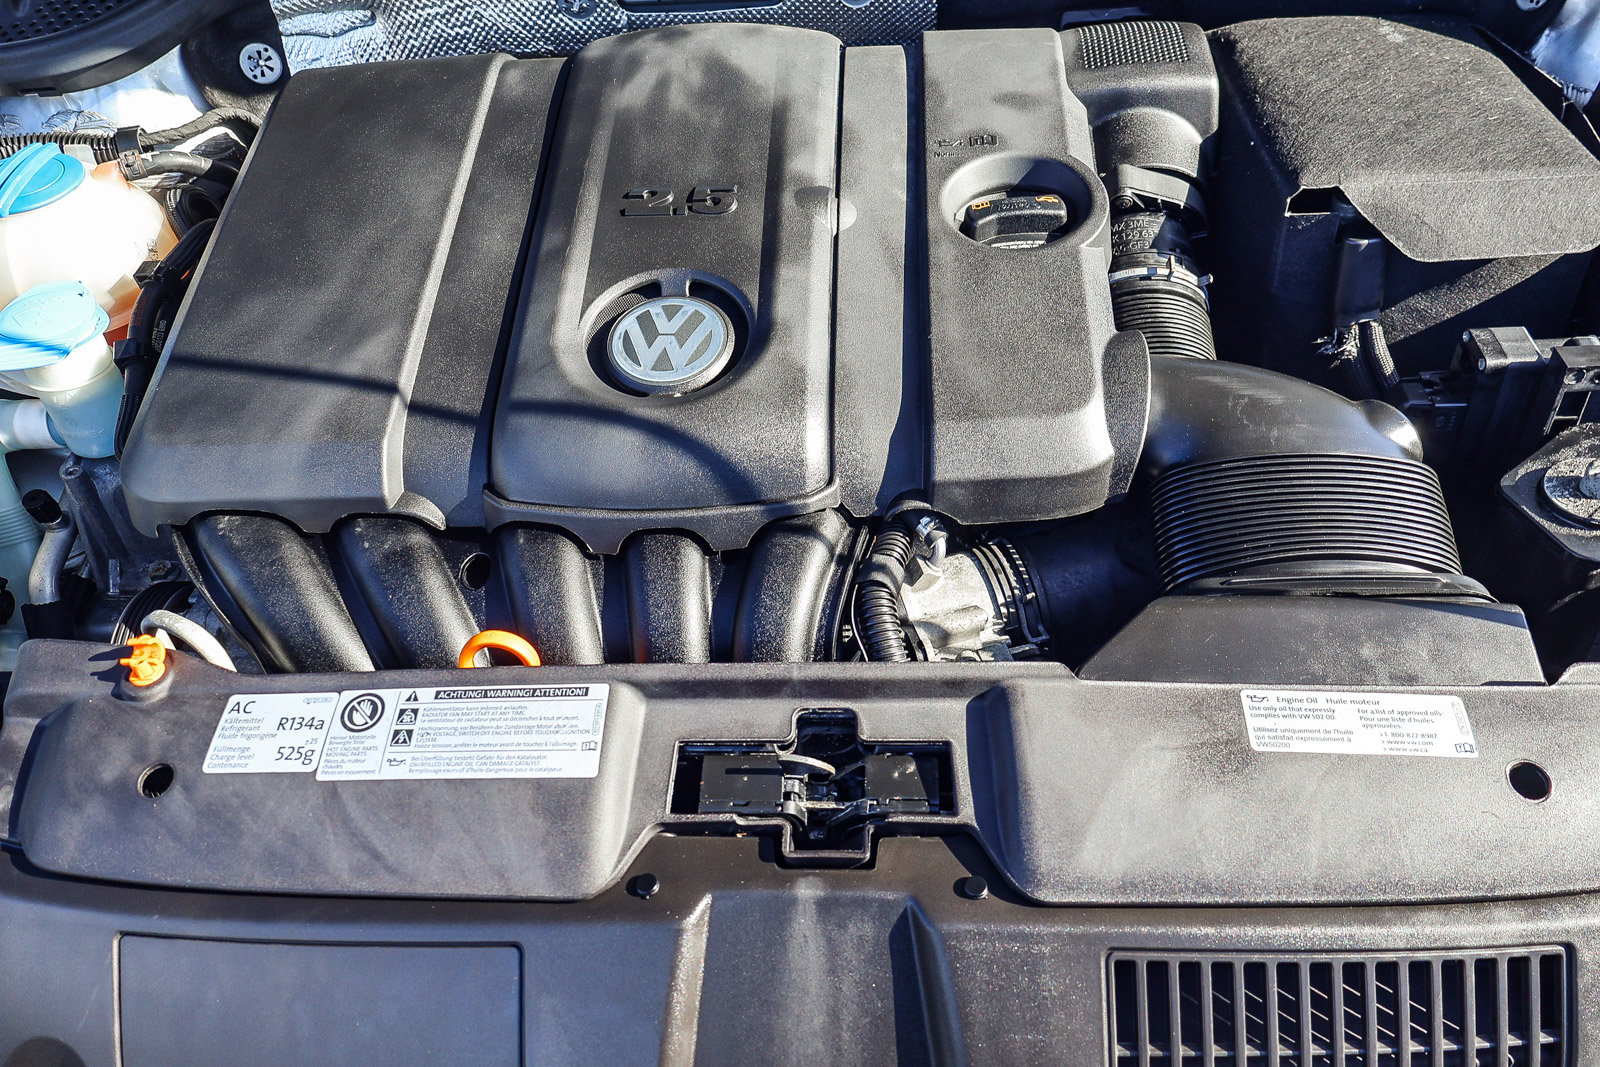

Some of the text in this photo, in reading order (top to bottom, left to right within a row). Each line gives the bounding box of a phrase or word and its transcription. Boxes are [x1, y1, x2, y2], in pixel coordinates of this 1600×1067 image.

[1121, 231, 1139, 240] 129
[608, 297, 734, 386] VW
[437, 688, 586, 699] ACHTUNG! WARNING! ATTENTION!
[1276, 696, 1305, 704] Engine
[228, 701, 256, 714] AC
[1396, 709, 1429, 717] approved
[277, 717, 325, 731] R134a
[213, 745, 251, 753] Füllmenge
[210, 754, 236, 762] Charge
[275, 747, 316, 765] 525g
